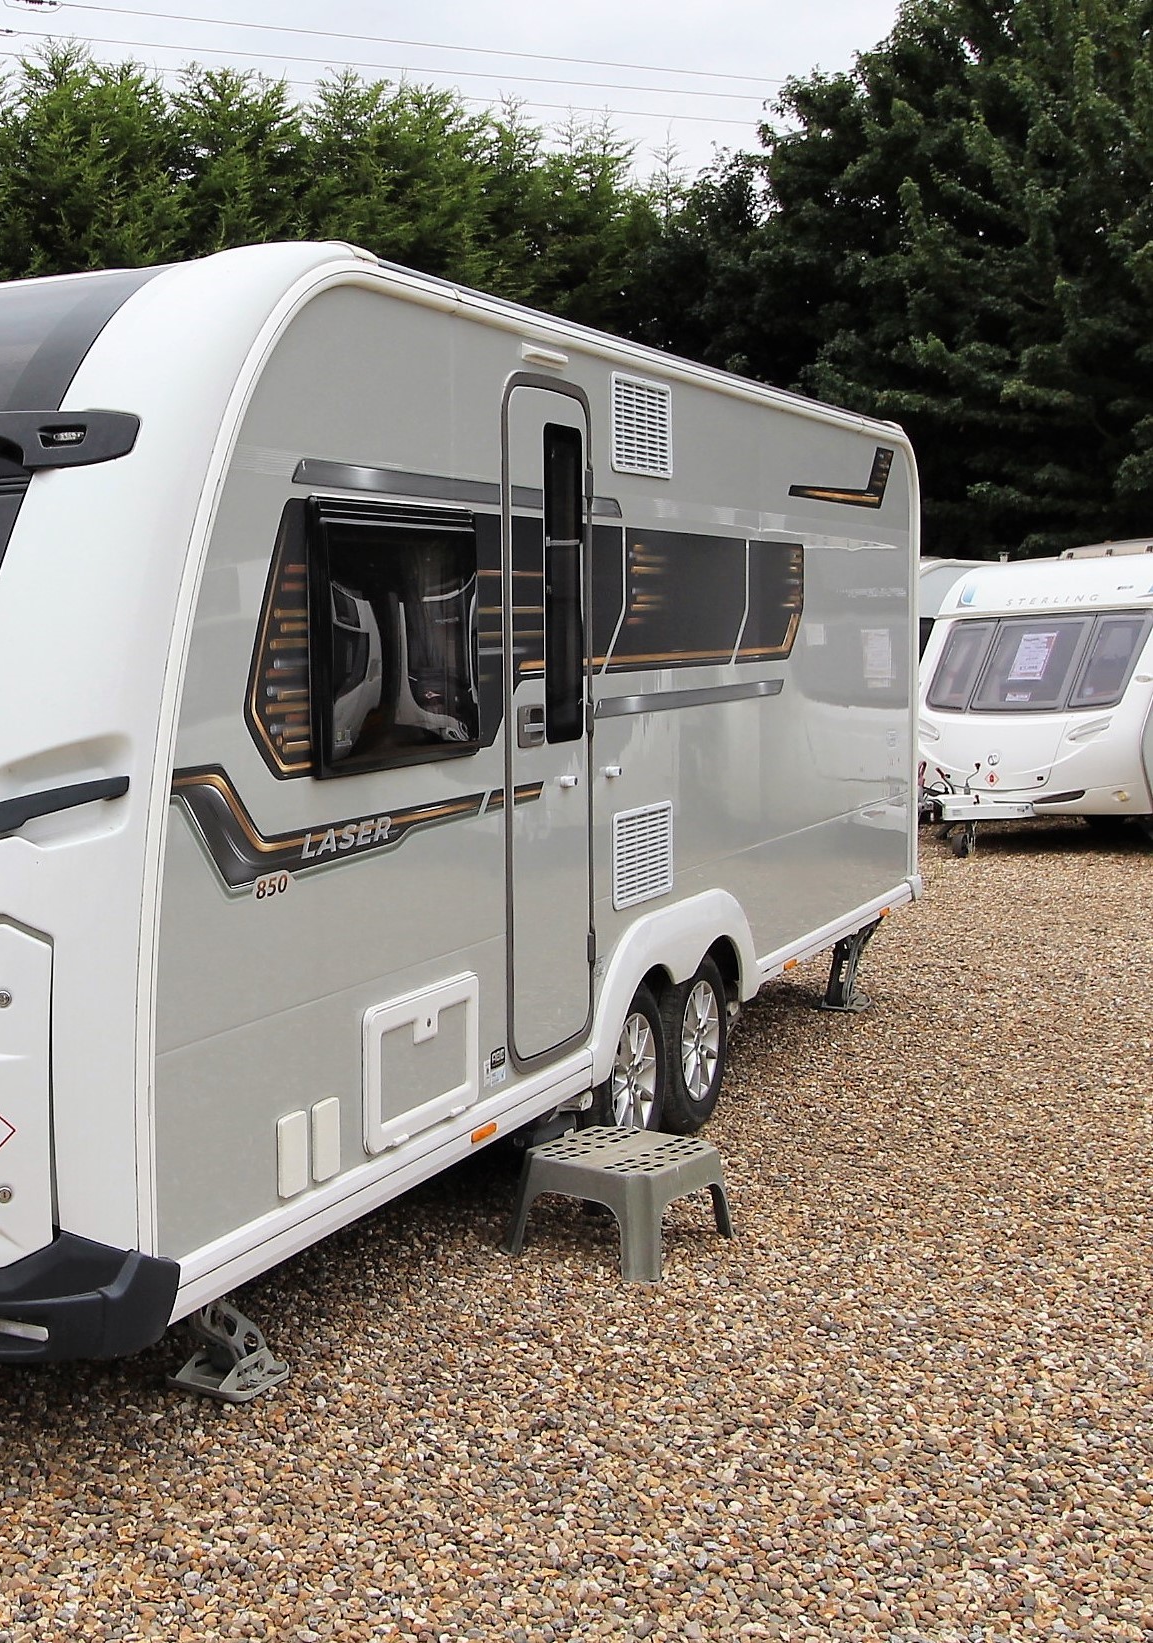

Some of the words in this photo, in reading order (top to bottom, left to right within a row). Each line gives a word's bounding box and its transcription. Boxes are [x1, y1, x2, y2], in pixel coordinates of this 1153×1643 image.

[1005, 593, 1100, 607] STERLING
[301, 816, 392, 860] LASER
[255, 874, 288, 900] 850
